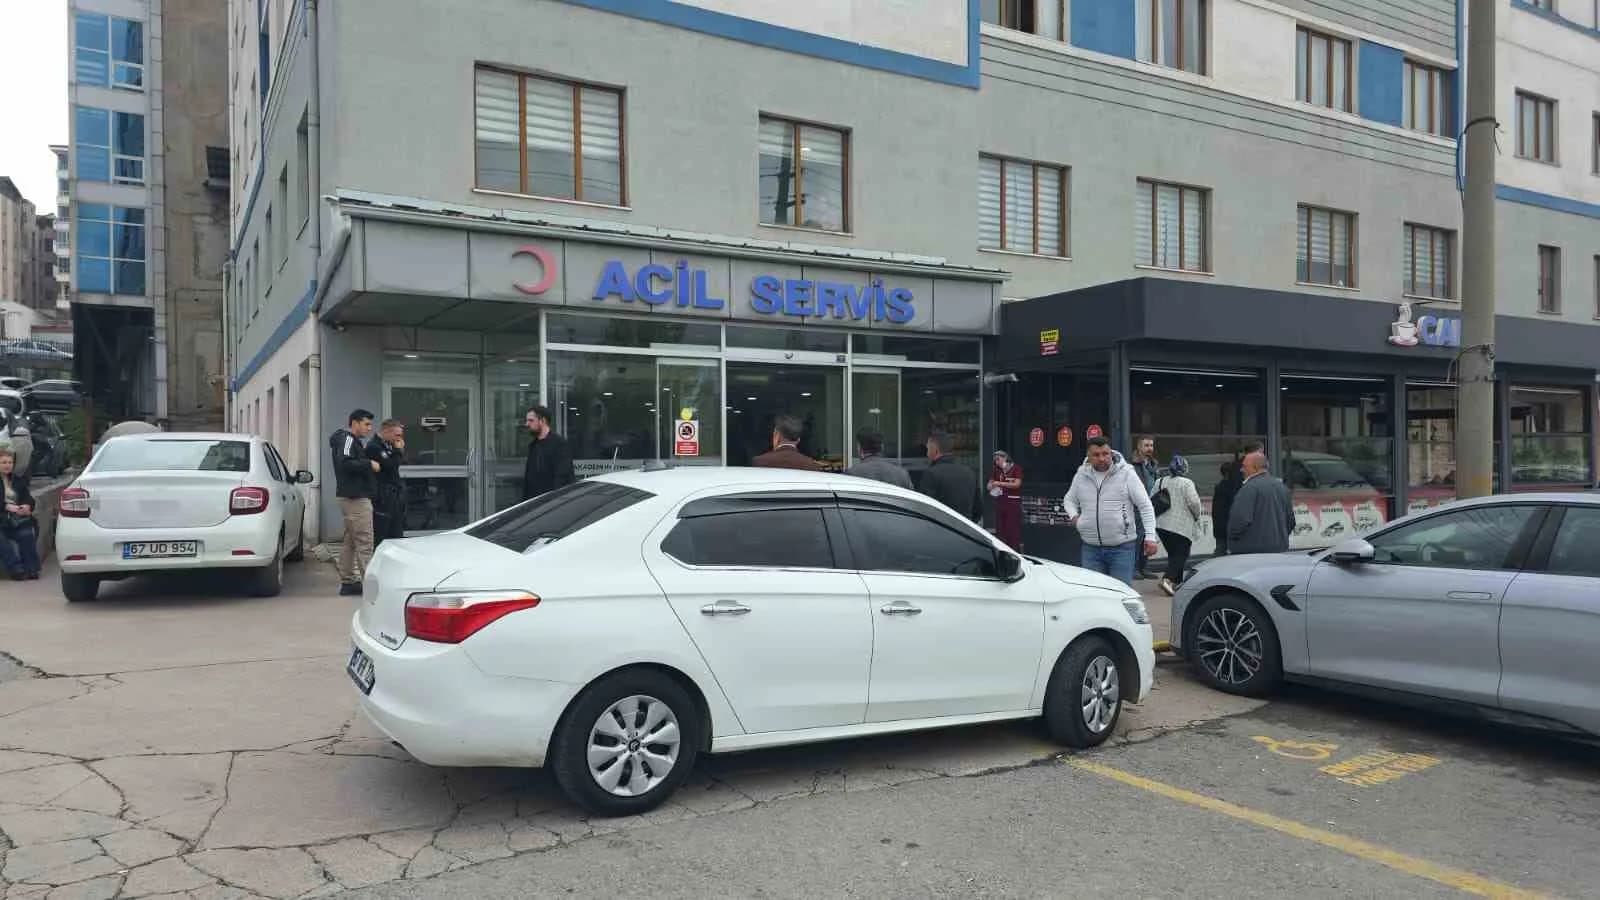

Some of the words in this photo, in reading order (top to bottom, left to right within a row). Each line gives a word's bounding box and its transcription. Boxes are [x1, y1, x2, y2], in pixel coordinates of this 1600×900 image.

[593, 259, 724, 310] ACİL
[750, 275, 915, 324] SERVİS
[130, 544, 145, 554] 67
[150, 543, 168, 553] UD
[171, 543, 194, 553] 954
